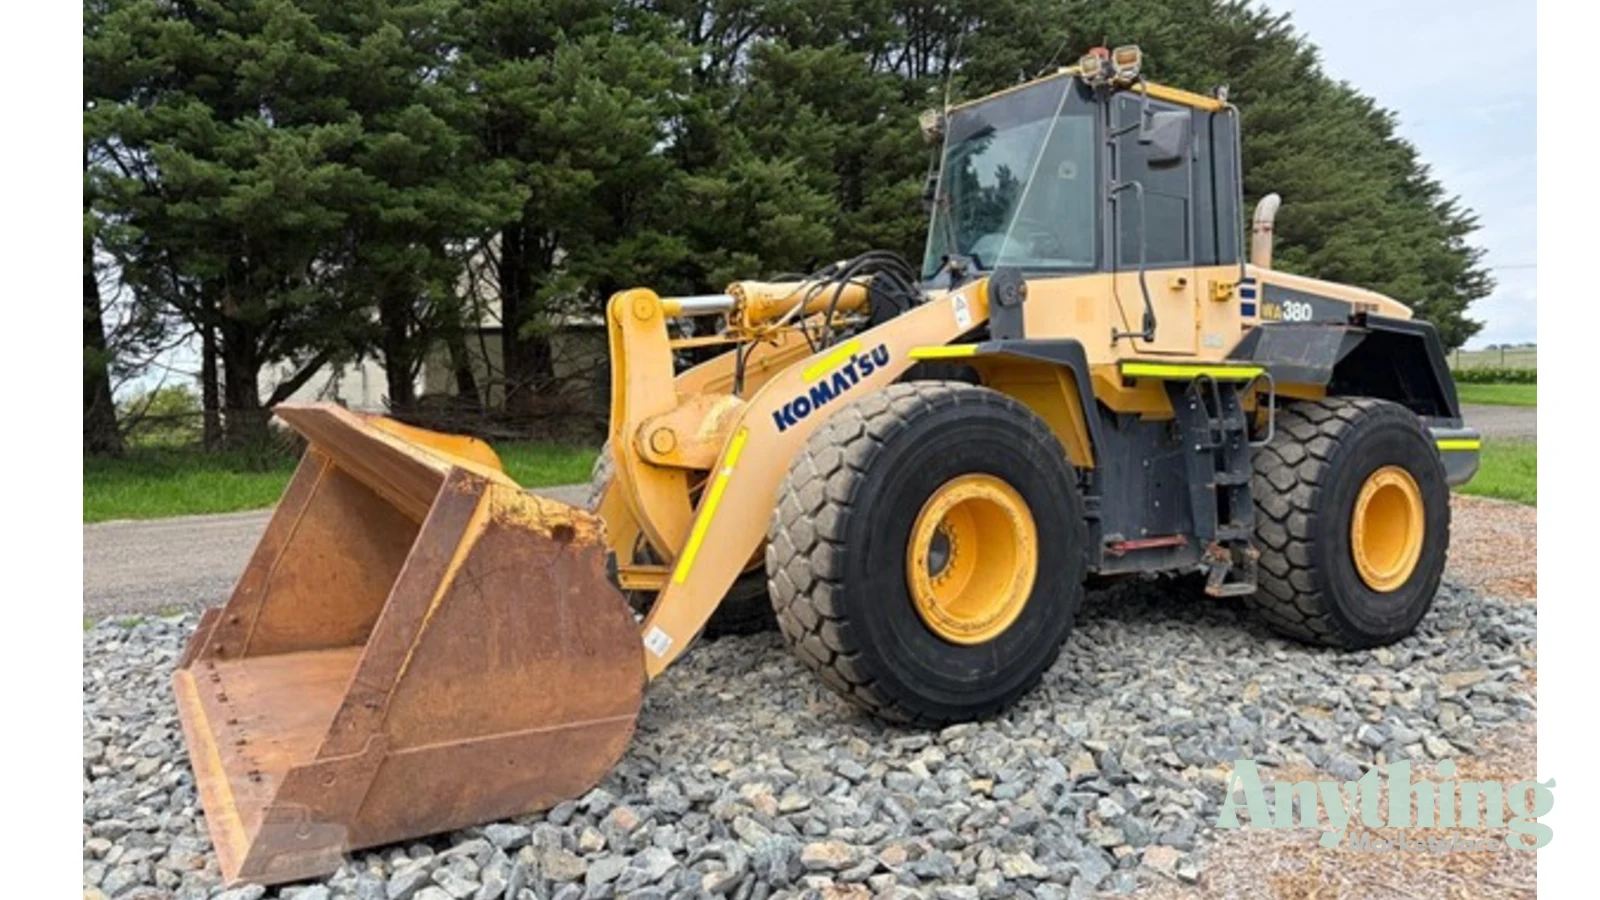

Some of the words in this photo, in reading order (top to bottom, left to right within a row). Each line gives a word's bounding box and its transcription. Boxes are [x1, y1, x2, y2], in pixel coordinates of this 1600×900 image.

[1262, 303, 1282, 320] WA
[1283, 300, 1313, 321] 380
[772, 344, 890, 432] KOMATSU
